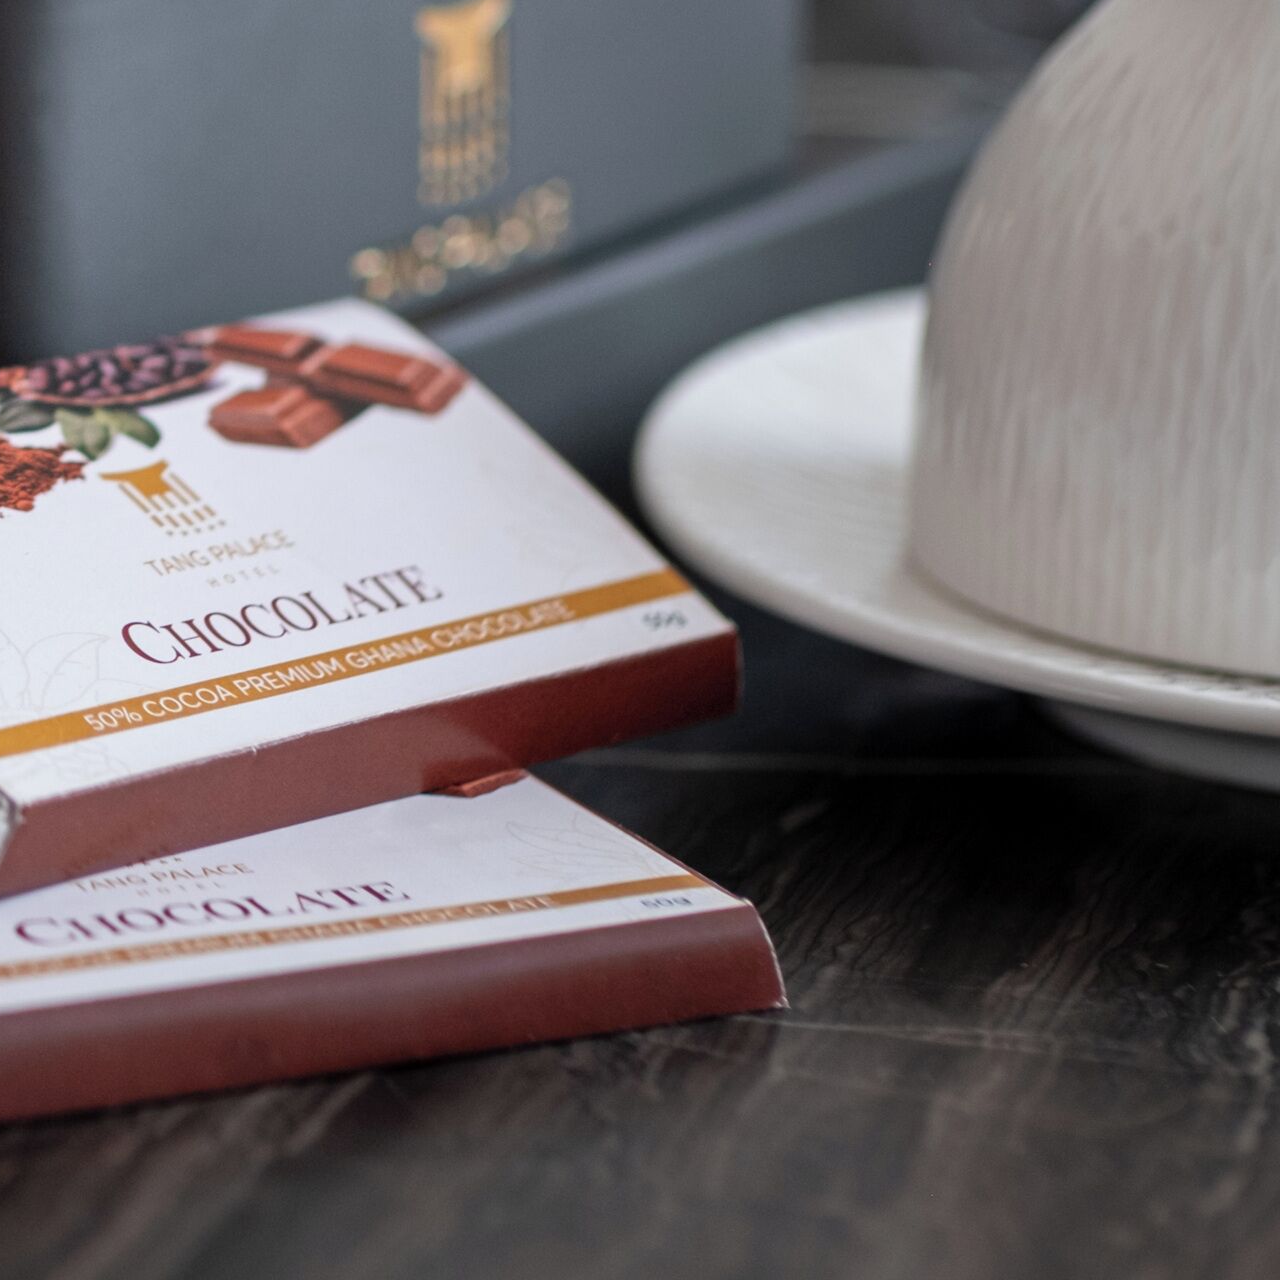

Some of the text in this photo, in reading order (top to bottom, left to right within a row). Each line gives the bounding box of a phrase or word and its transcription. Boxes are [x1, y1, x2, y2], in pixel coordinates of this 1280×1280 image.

[144, 528, 296, 577] TANG PALACE
[206, 563, 282, 588] HOTEL
[120, 565, 444, 665] CHOCOLATE
[83, 598, 577, 732] 50% COCOA PREMIUM GHANA CHOCOLATE
[72, 862, 255, 895] TANG PALACE
[14, 881, 412, 948] CHOCOLATE
